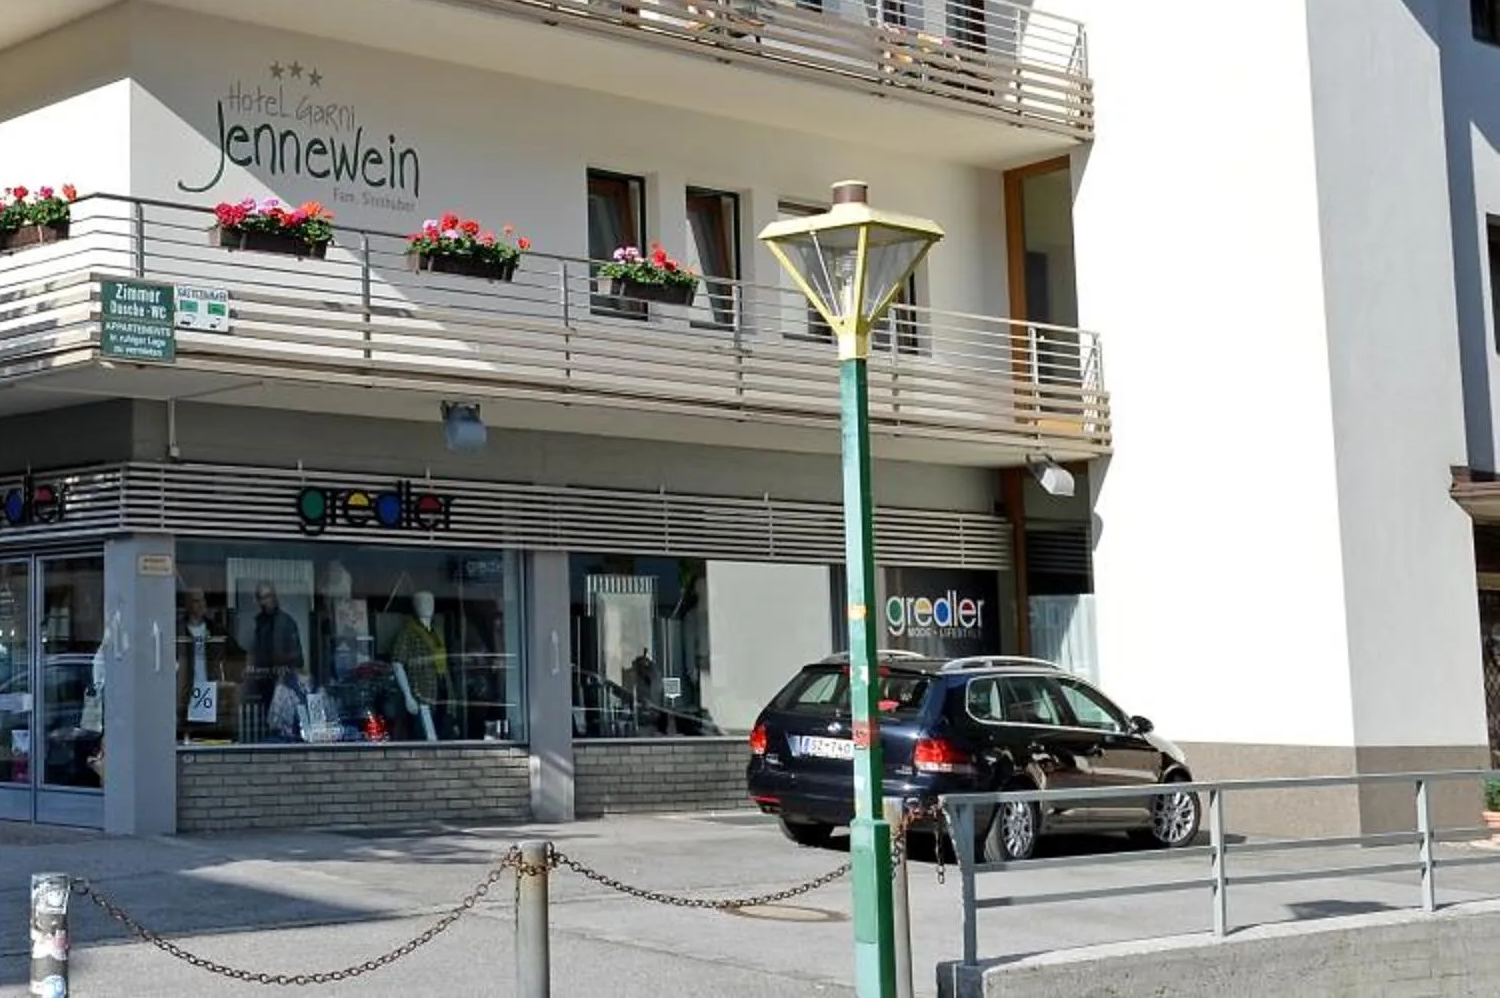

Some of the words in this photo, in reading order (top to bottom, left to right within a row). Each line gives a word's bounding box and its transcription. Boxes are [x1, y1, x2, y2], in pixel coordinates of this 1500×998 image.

[115, 283, 162, 303] Zimmer
[297, 480, 455, 536] gredler
[885, 589, 985, 636] gredler
